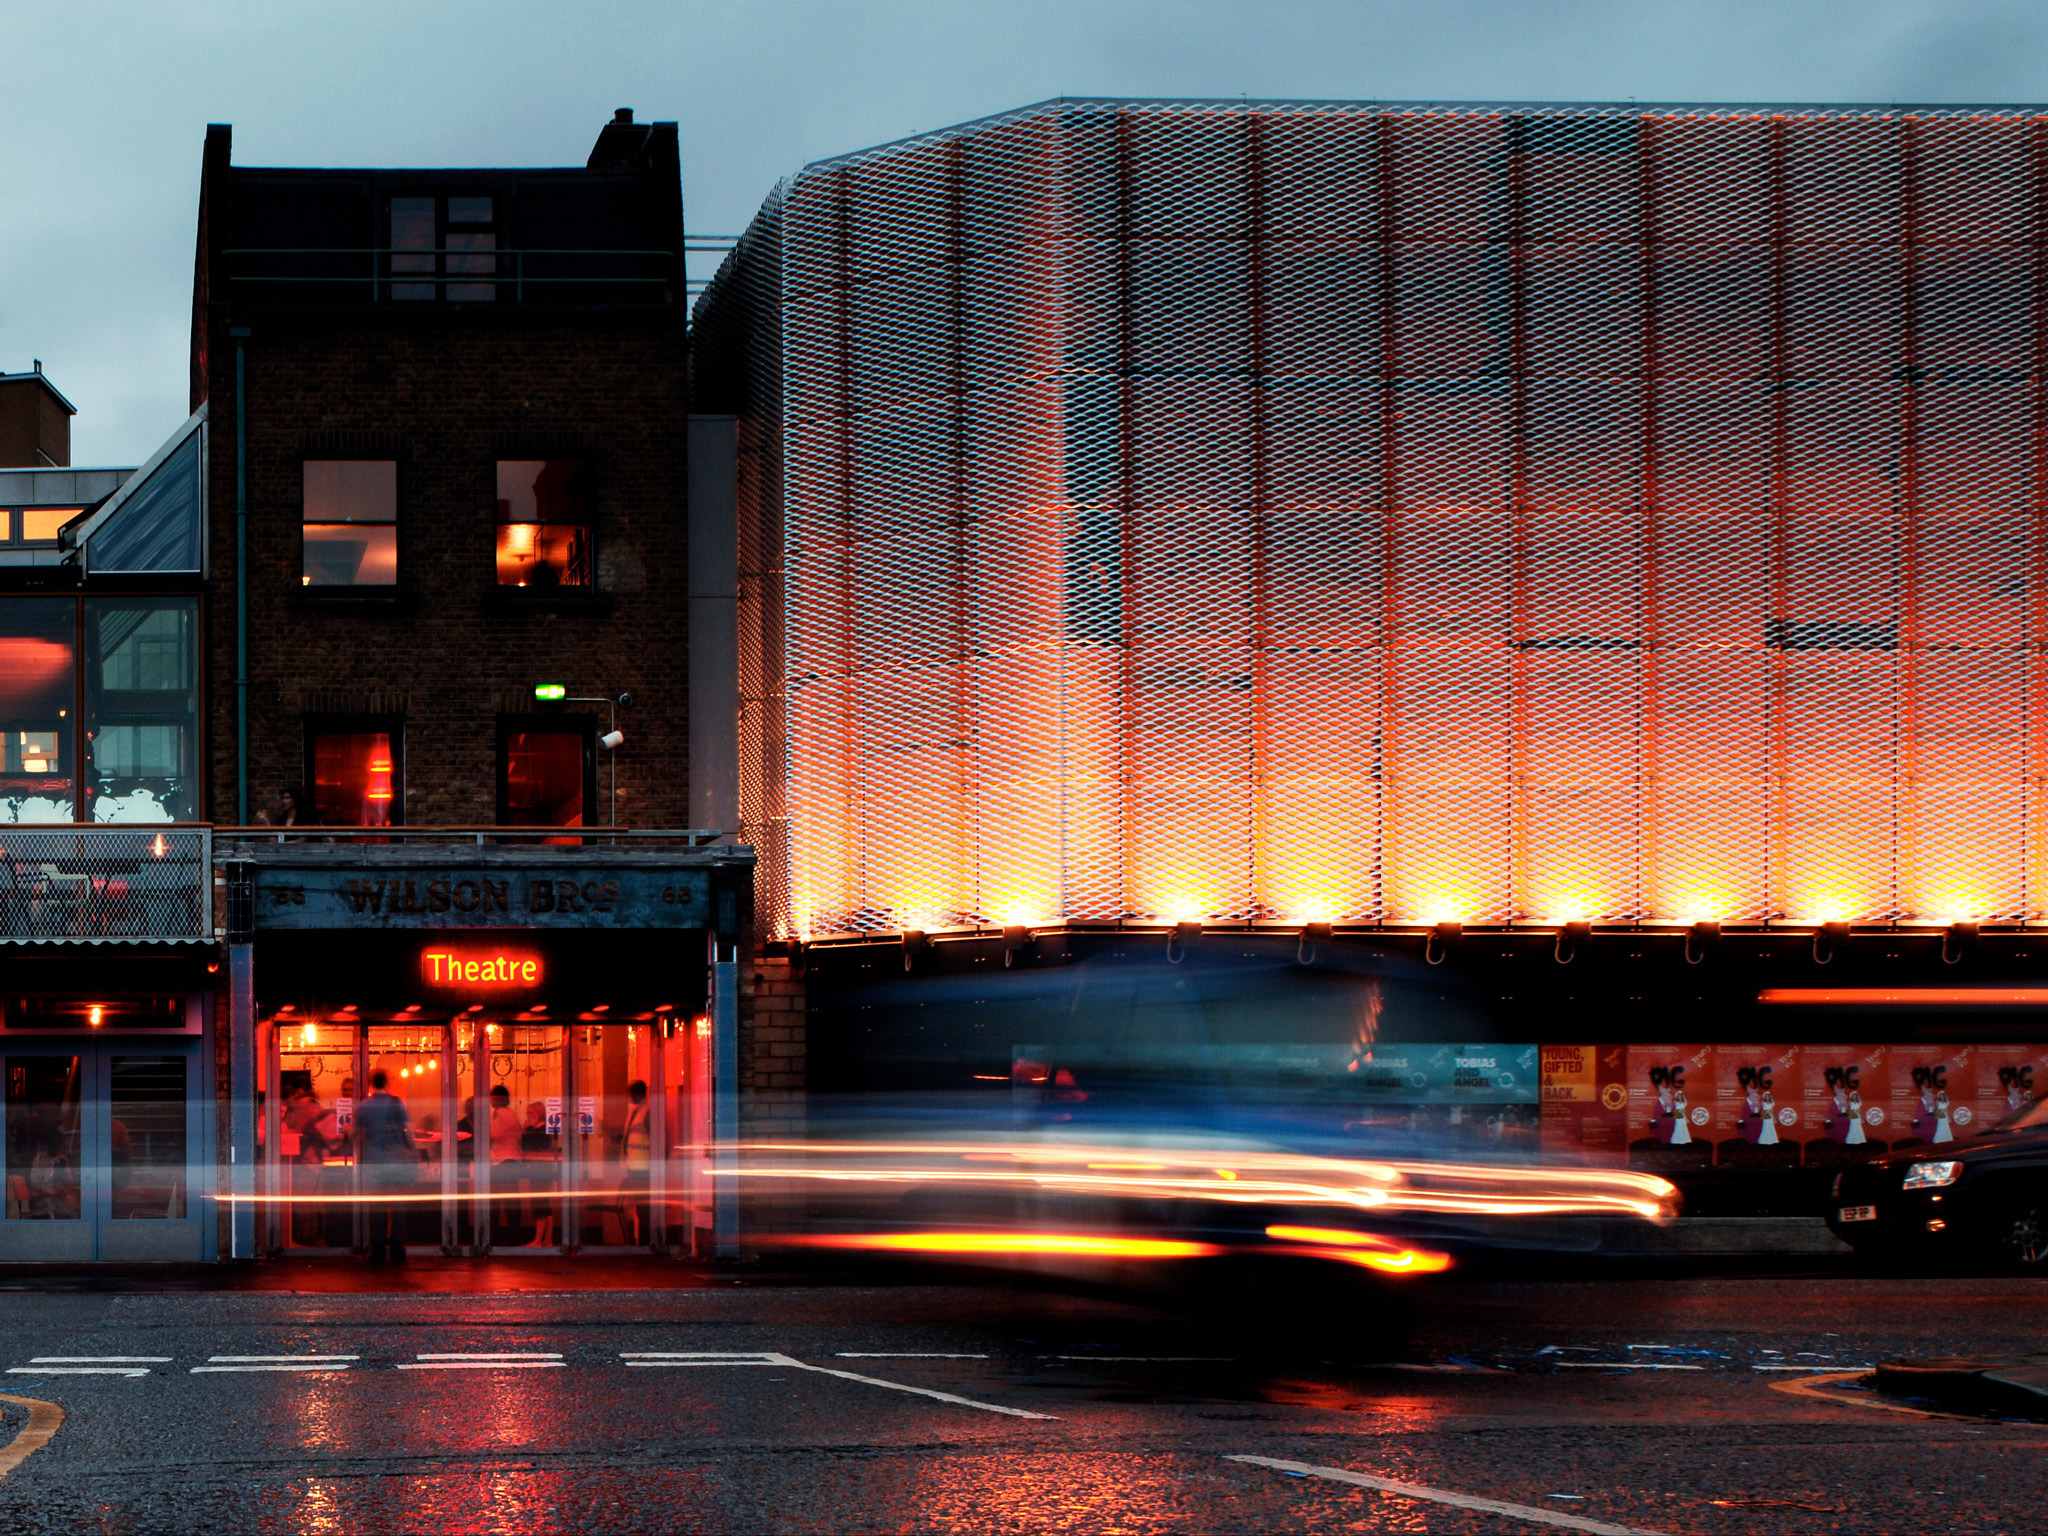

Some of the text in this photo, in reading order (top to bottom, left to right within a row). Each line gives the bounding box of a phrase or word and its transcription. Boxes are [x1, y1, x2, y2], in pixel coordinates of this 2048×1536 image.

[347, 878, 510, 914] WILSON
[661, 885, 692, 905] 66
[426, 954, 537, 981] Theatre
[1454, 1058, 1497, 1068] TOBIAS
[1544, 1048, 1584, 1062] YOUNG,
[1454, 1068, 1479, 1077] AND
[1544, 1061, 1582, 1073] GIFTED
[1454, 1078, 1491, 1087] ANGEL
[1544, 1074, 1553, 1086] &
[1649, 1066, 1685, 1090] PIG
[1738, 1066, 1773, 1091] PIG
[1824, 1066, 1860, 1091] PIG
[1912, 1065, 1947, 1091] PIG
[1999, 1065, 2034, 1091] PIG
[1544, 1087, 1577, 1100] BACK.
